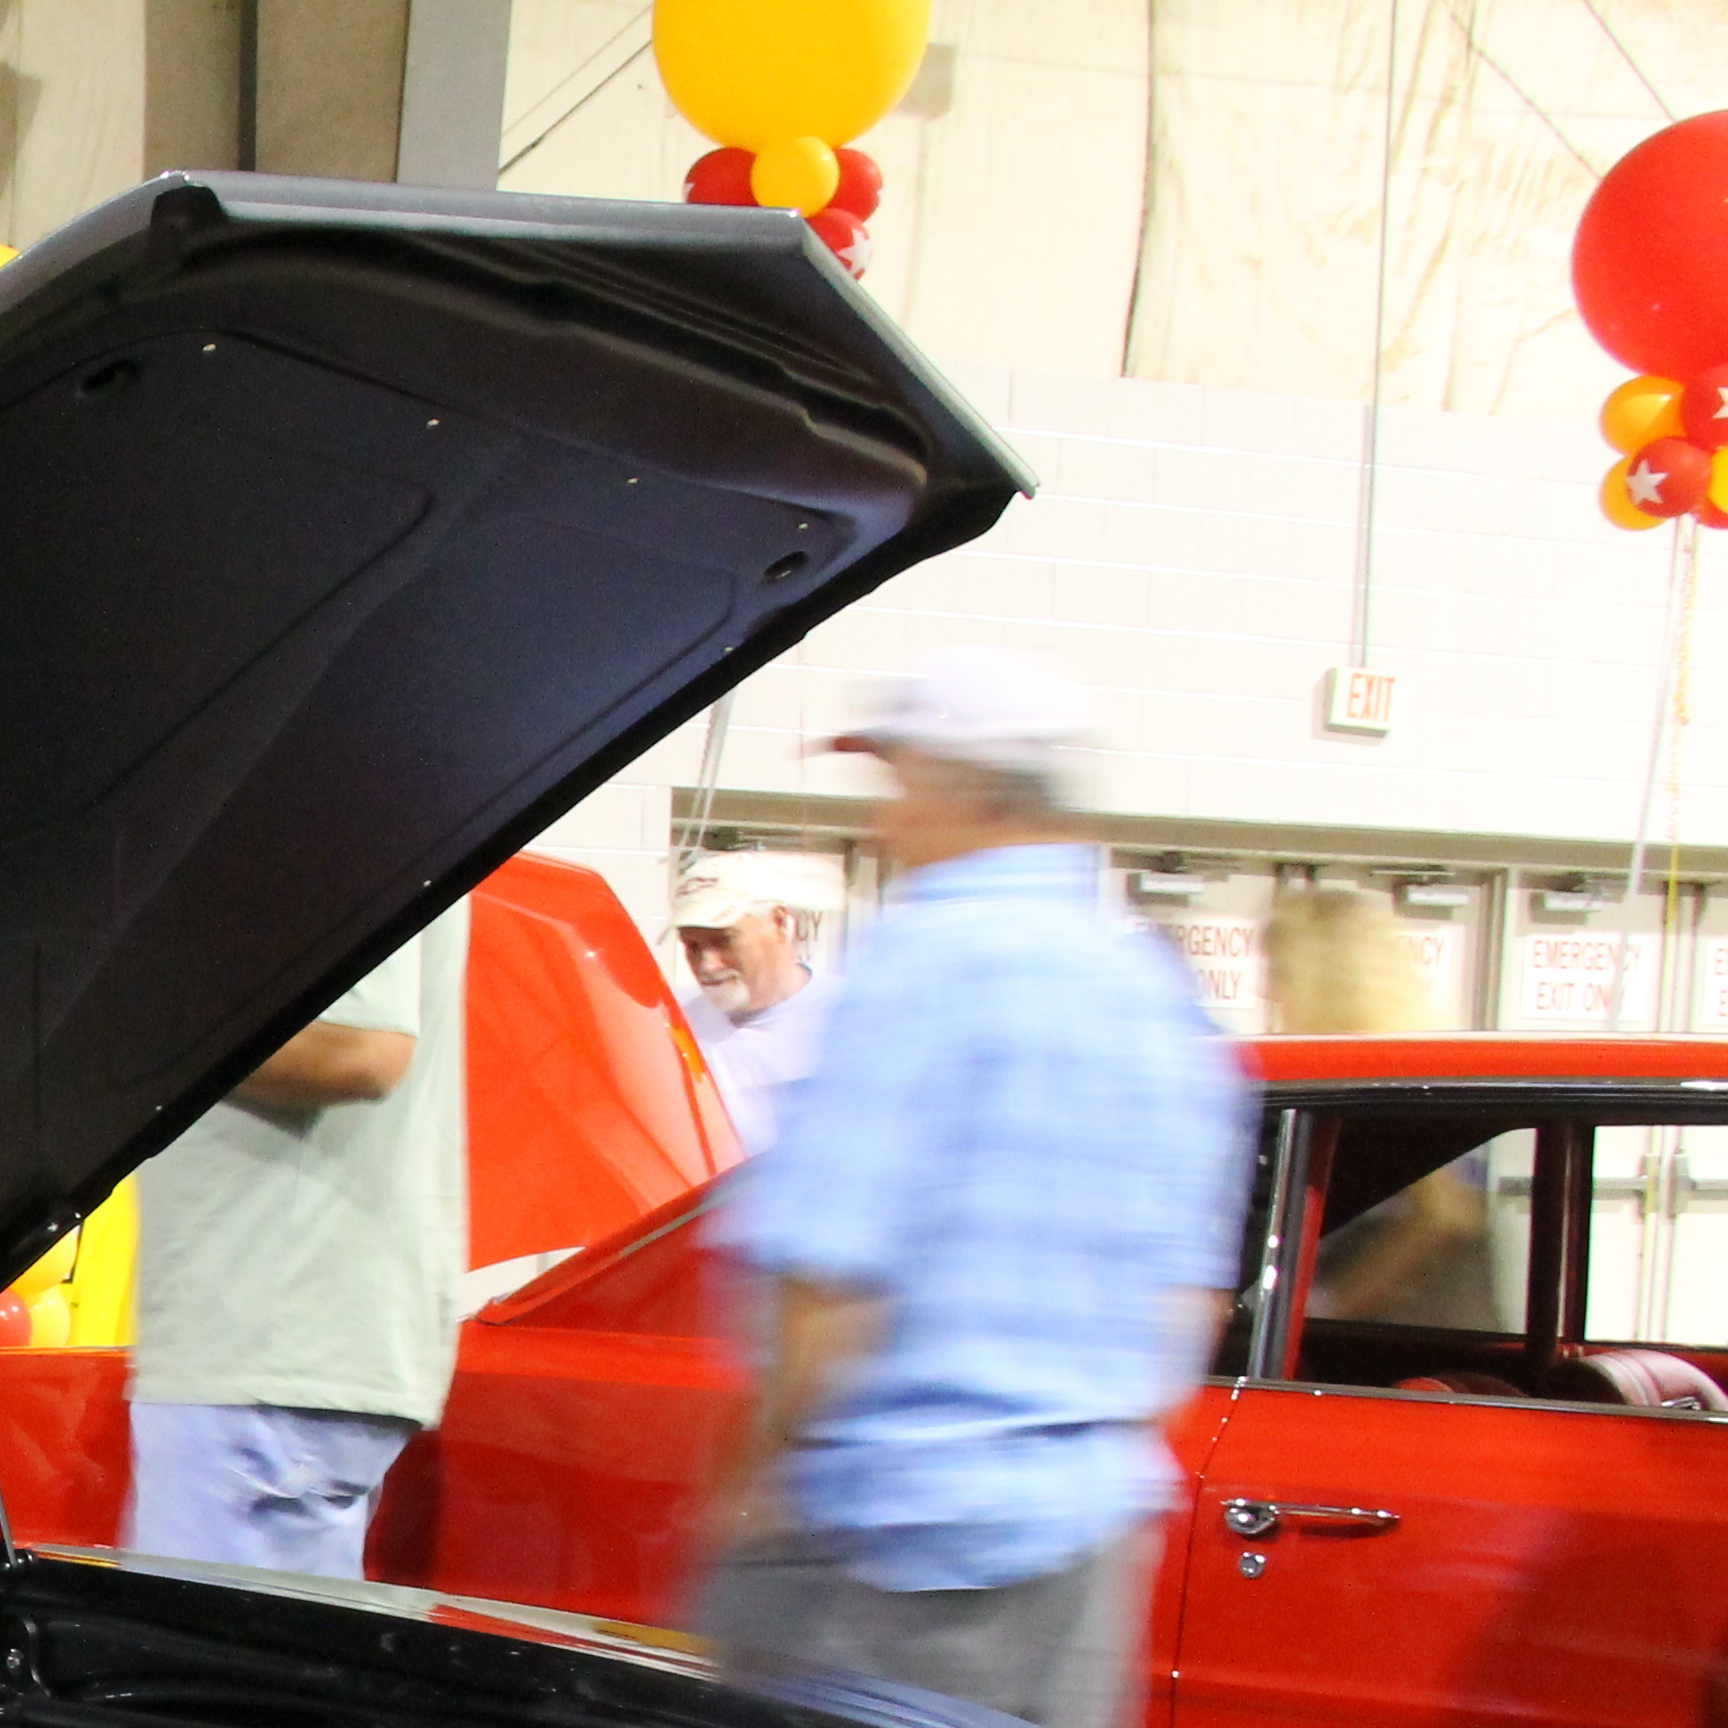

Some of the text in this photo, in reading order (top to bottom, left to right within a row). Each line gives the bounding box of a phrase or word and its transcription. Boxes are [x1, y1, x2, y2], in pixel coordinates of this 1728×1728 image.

[1346, 672, 1397, 722] EXIT
[1140, 923, 1255, 958] RGENCY
[1536, 980, 1627, 1014] EXIT ON
